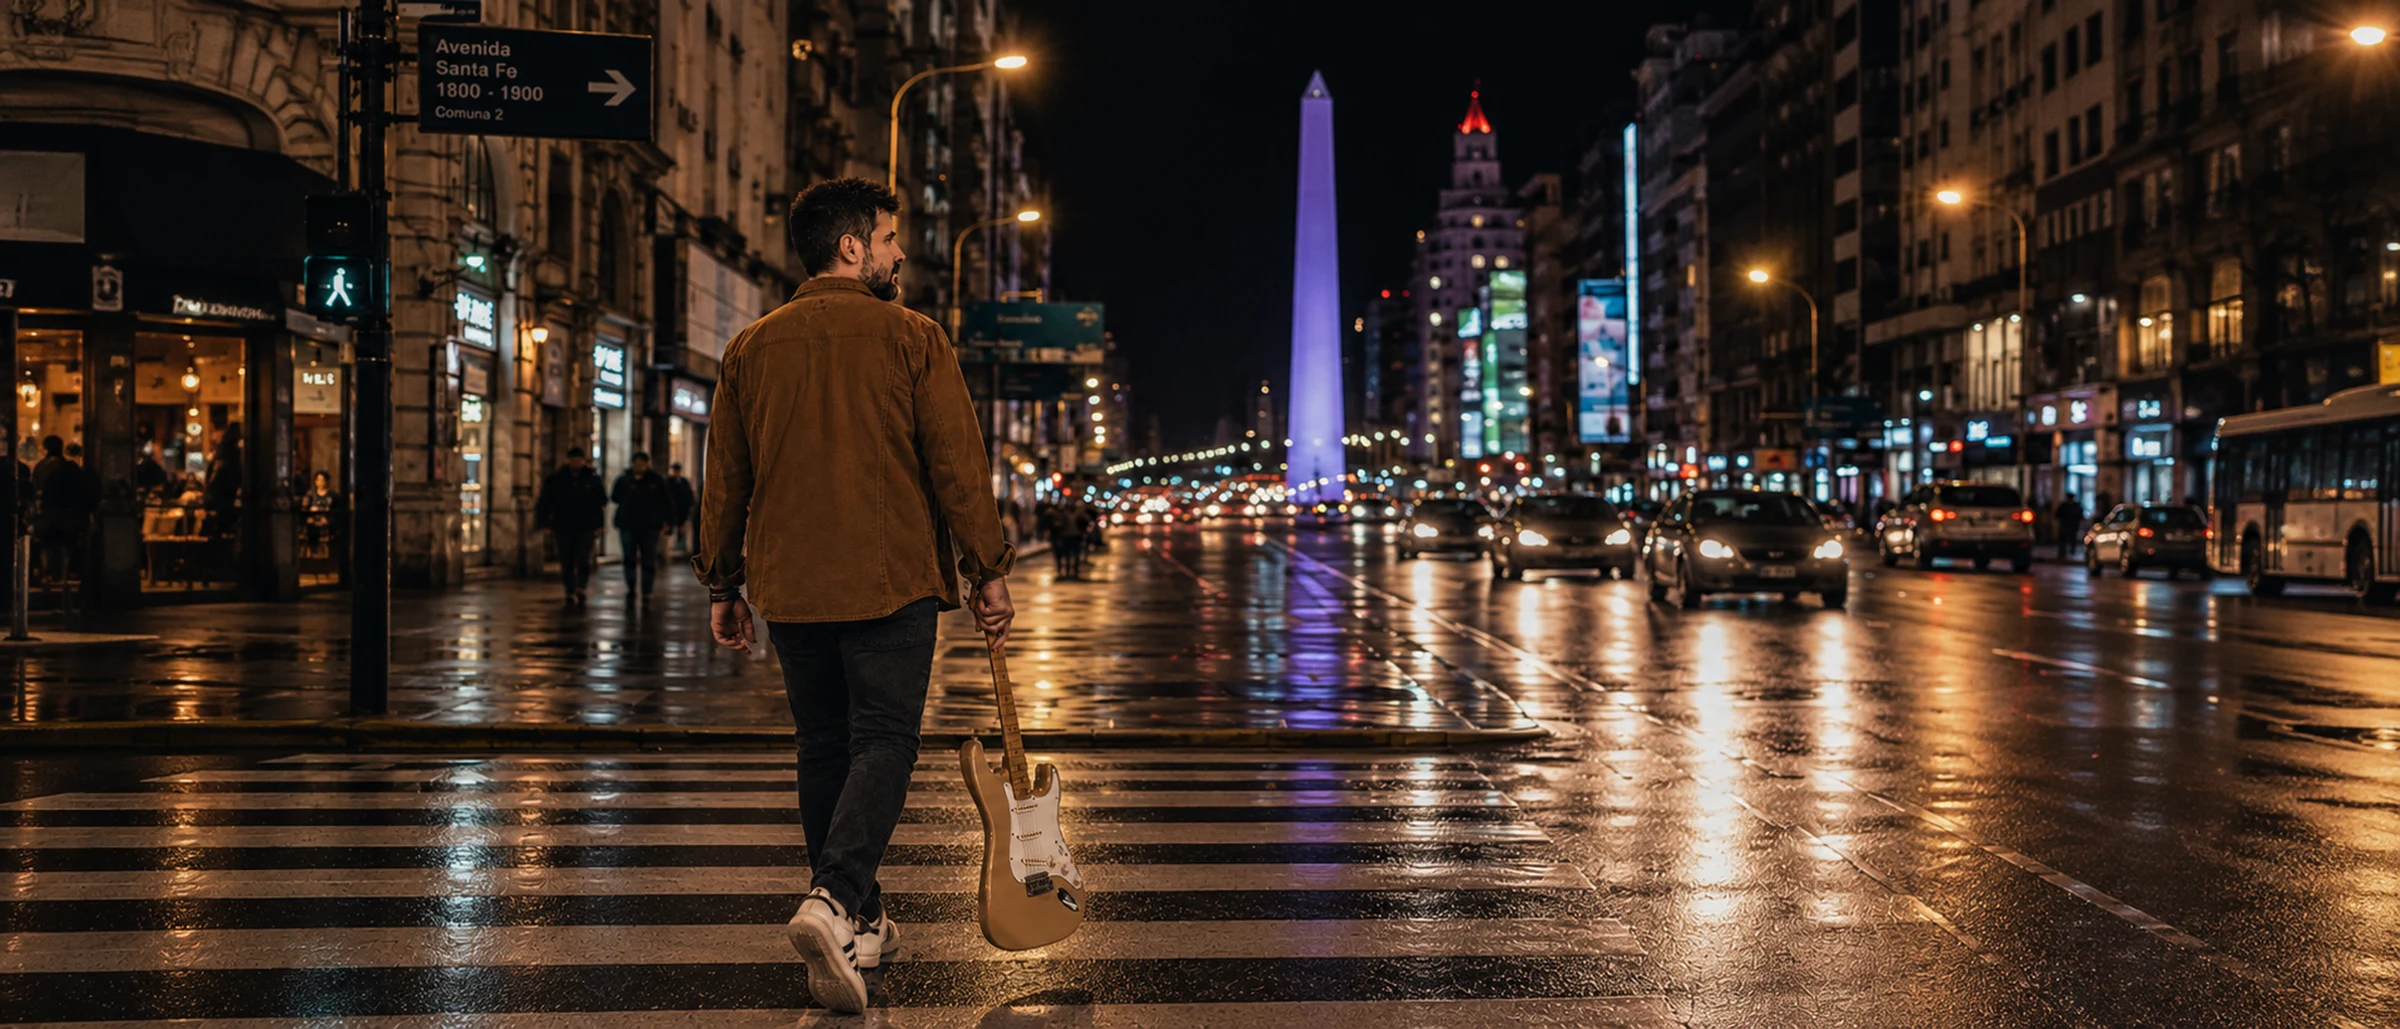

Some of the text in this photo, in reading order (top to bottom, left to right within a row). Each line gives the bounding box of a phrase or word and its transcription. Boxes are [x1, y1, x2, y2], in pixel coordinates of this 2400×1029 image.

[436, 39, 511, 57] Avenida
[436, 60, 518, 79] Santa Fe
[436, 83, 481, 99] 1800
[501, 86, 544, 101] 1900
[435, 106, 504, 121] Comuna 2
